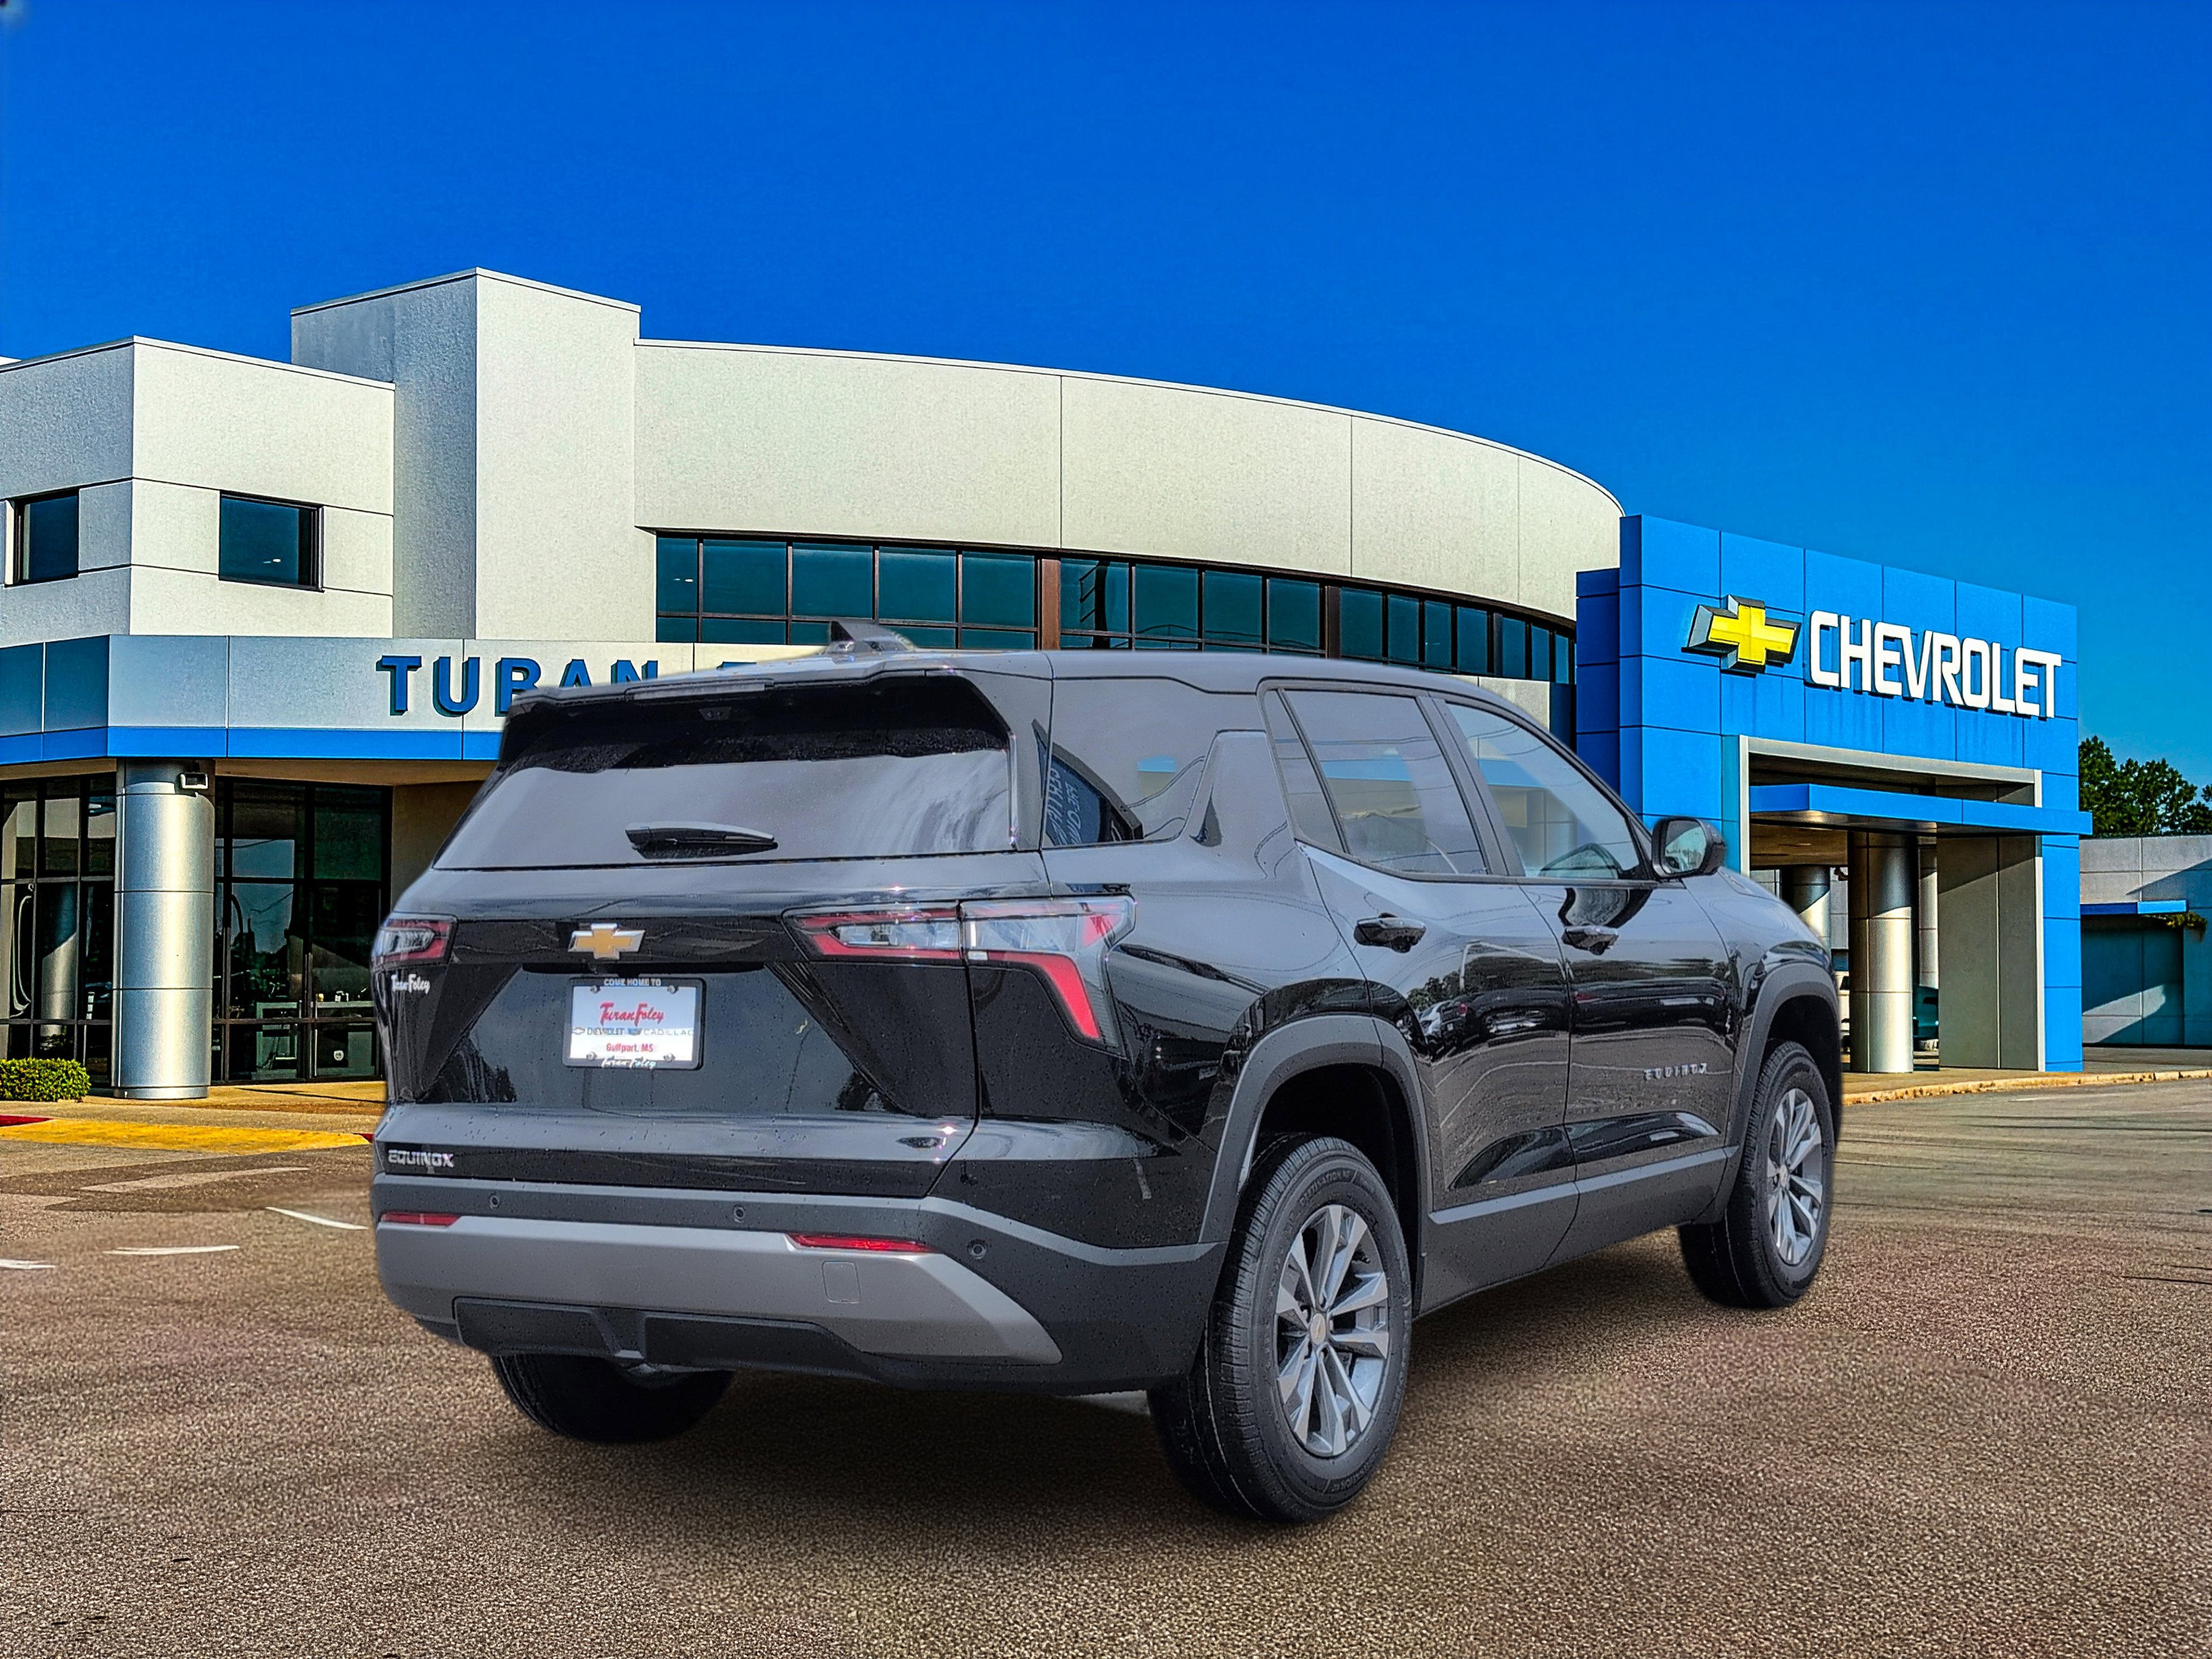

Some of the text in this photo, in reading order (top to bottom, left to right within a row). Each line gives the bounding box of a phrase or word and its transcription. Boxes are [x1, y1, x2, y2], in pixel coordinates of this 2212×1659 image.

[1810, 609, 2062, 720] CHEVROLET
[603, 978, 661, 986] COME HOME TO
[641, 1044, 654, 1052] MS
[388, 1149, 454, 1167] EQUINOX
